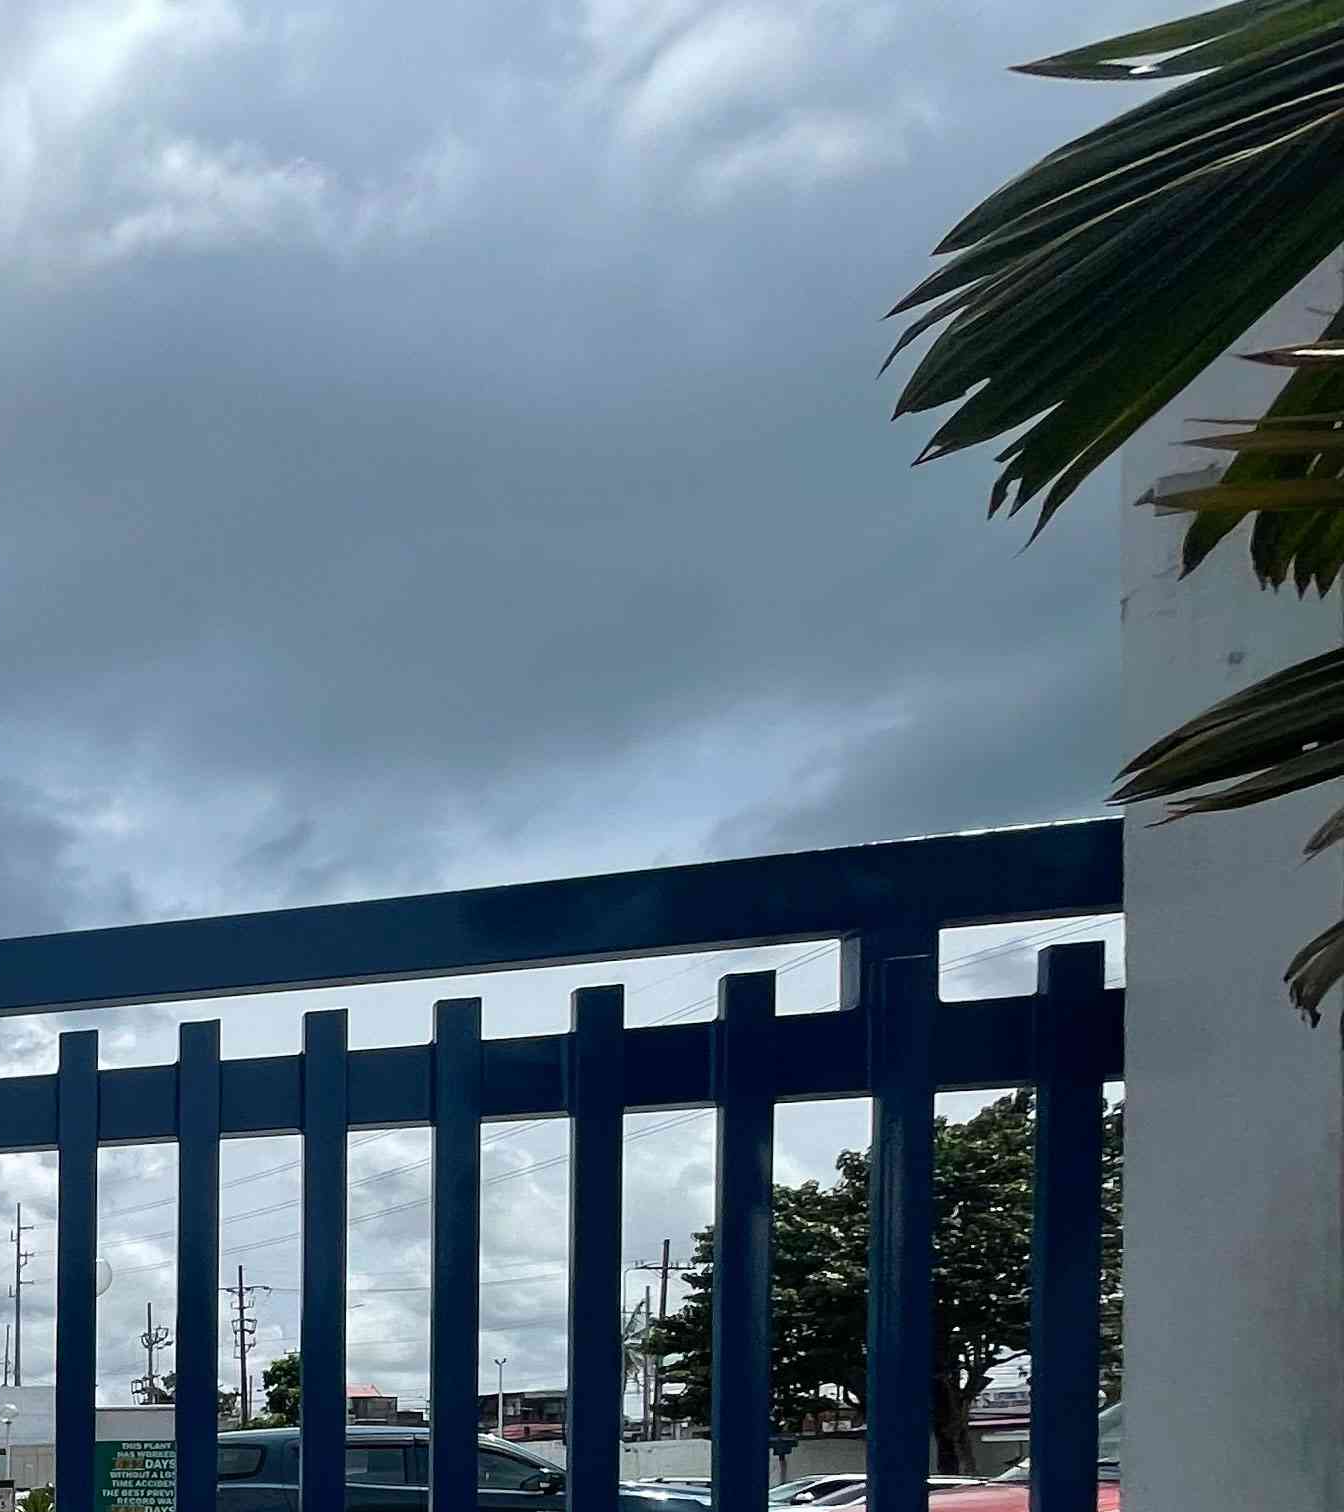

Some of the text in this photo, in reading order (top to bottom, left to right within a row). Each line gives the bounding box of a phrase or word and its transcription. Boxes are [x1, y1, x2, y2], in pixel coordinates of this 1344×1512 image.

[144, 1442, 172, 1450] PLANT
[145, 1459, 177, 1469] DAYS
[110, 1471, 150, 1479] WITHOUT
[151, 1471, 159, 1479] A
[112, 1480, 135, 1488] TIME
[121, 1489, 146, 1497] BEST
[147, 1489, 175, 1497] PREVI
[117, 1497, 156, 1505] RECORD
